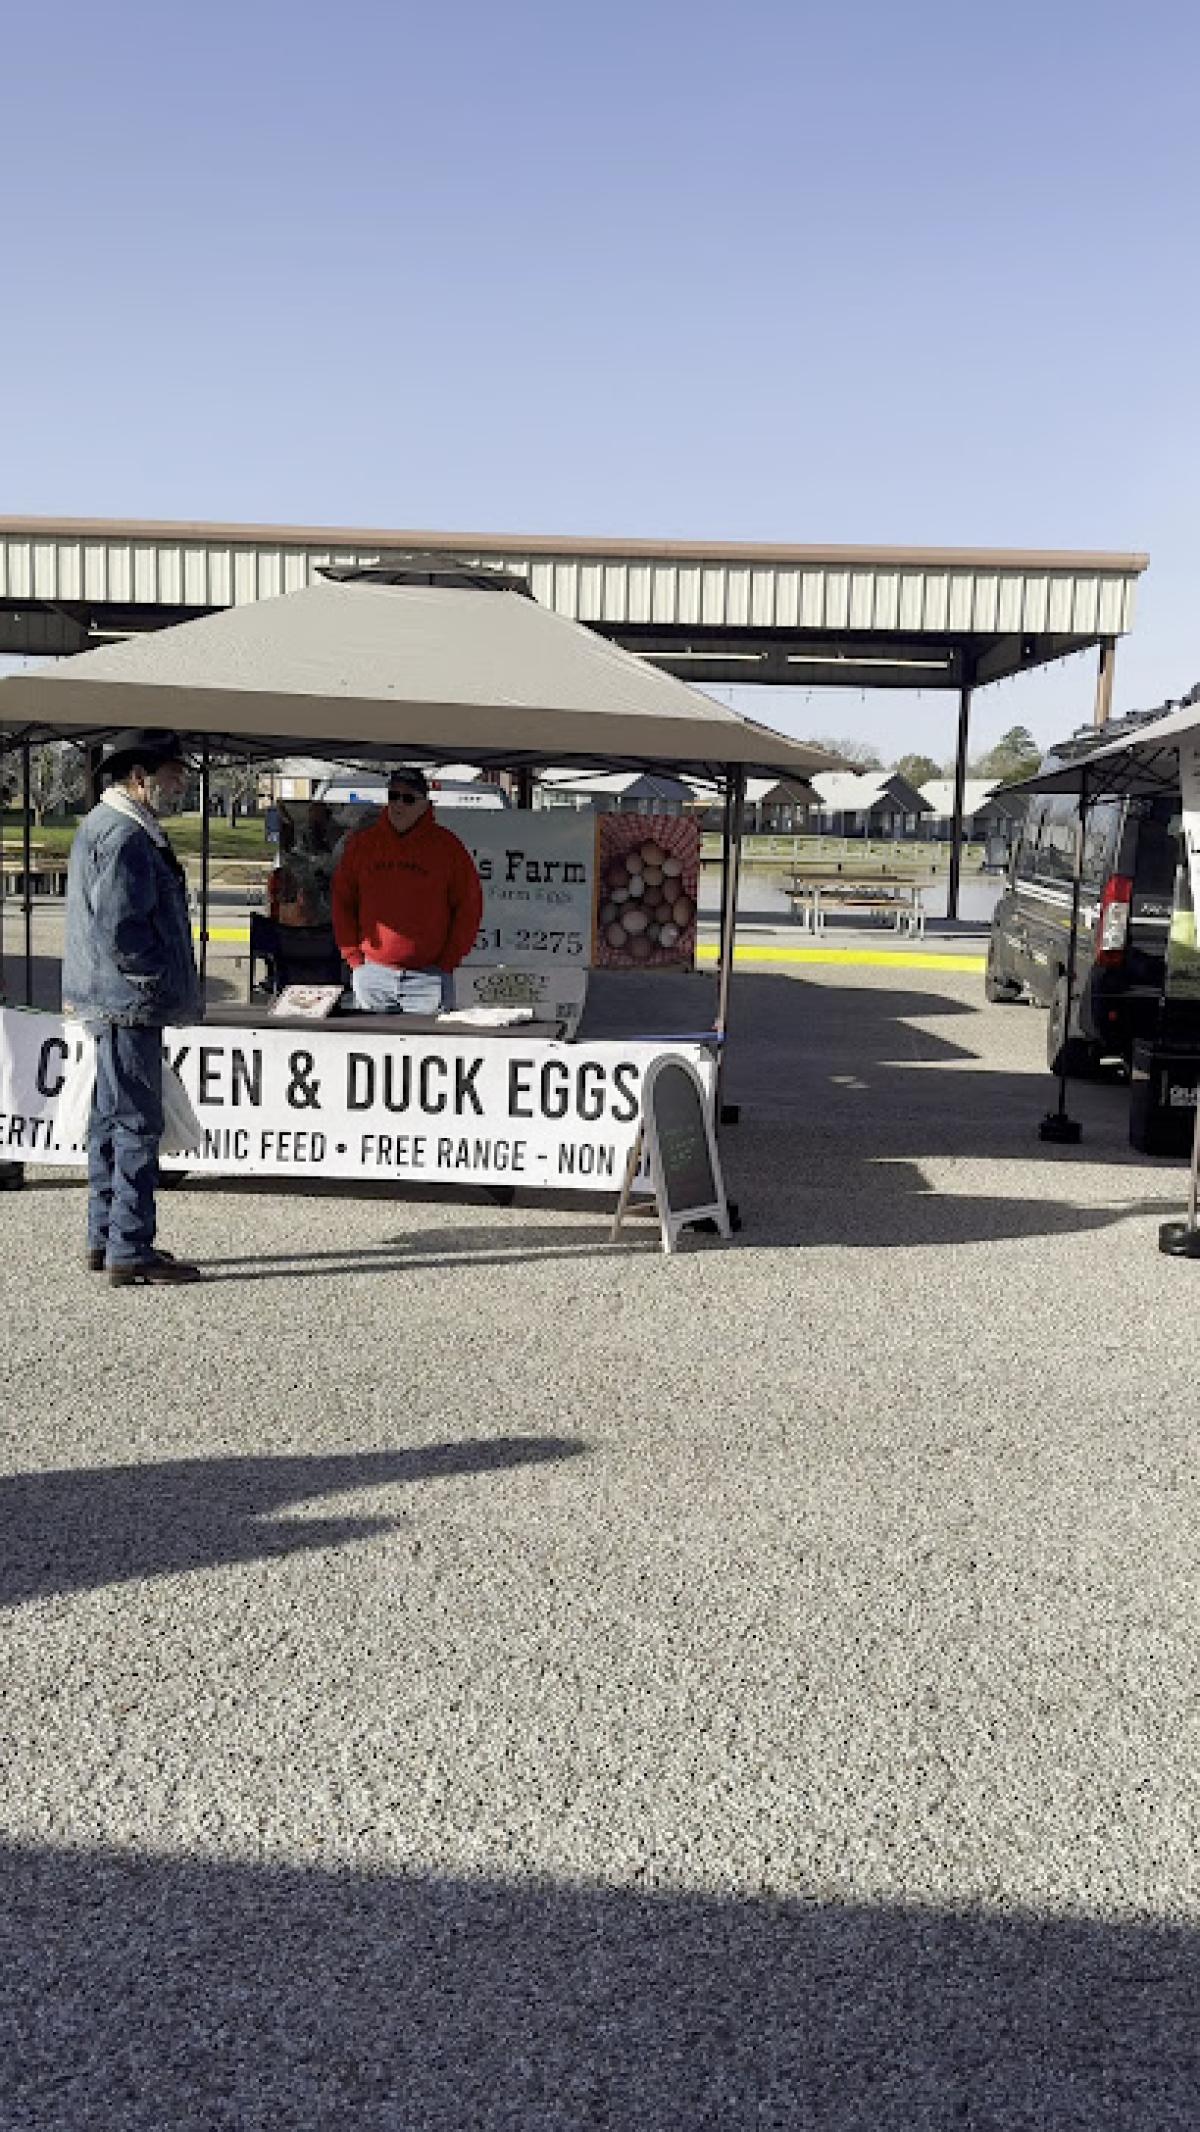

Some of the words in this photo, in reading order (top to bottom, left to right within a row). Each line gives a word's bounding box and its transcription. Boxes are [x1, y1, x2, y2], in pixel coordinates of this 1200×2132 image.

[505, 849, 586, 883] Farm
[37, 1037, 263, 1107] CKEN
[286, 1049, 322, 1110] &
[346, 1052, 486, 1116] DUCK
[508, 1058, 639, 1122] EGGS
[260, 1131, 327, 1163] FEED
[361, 1134, 427, 1168] FREE
[437, 1138, 528, 1172] RANGE
[558, 1143, 616, 1177] NON
